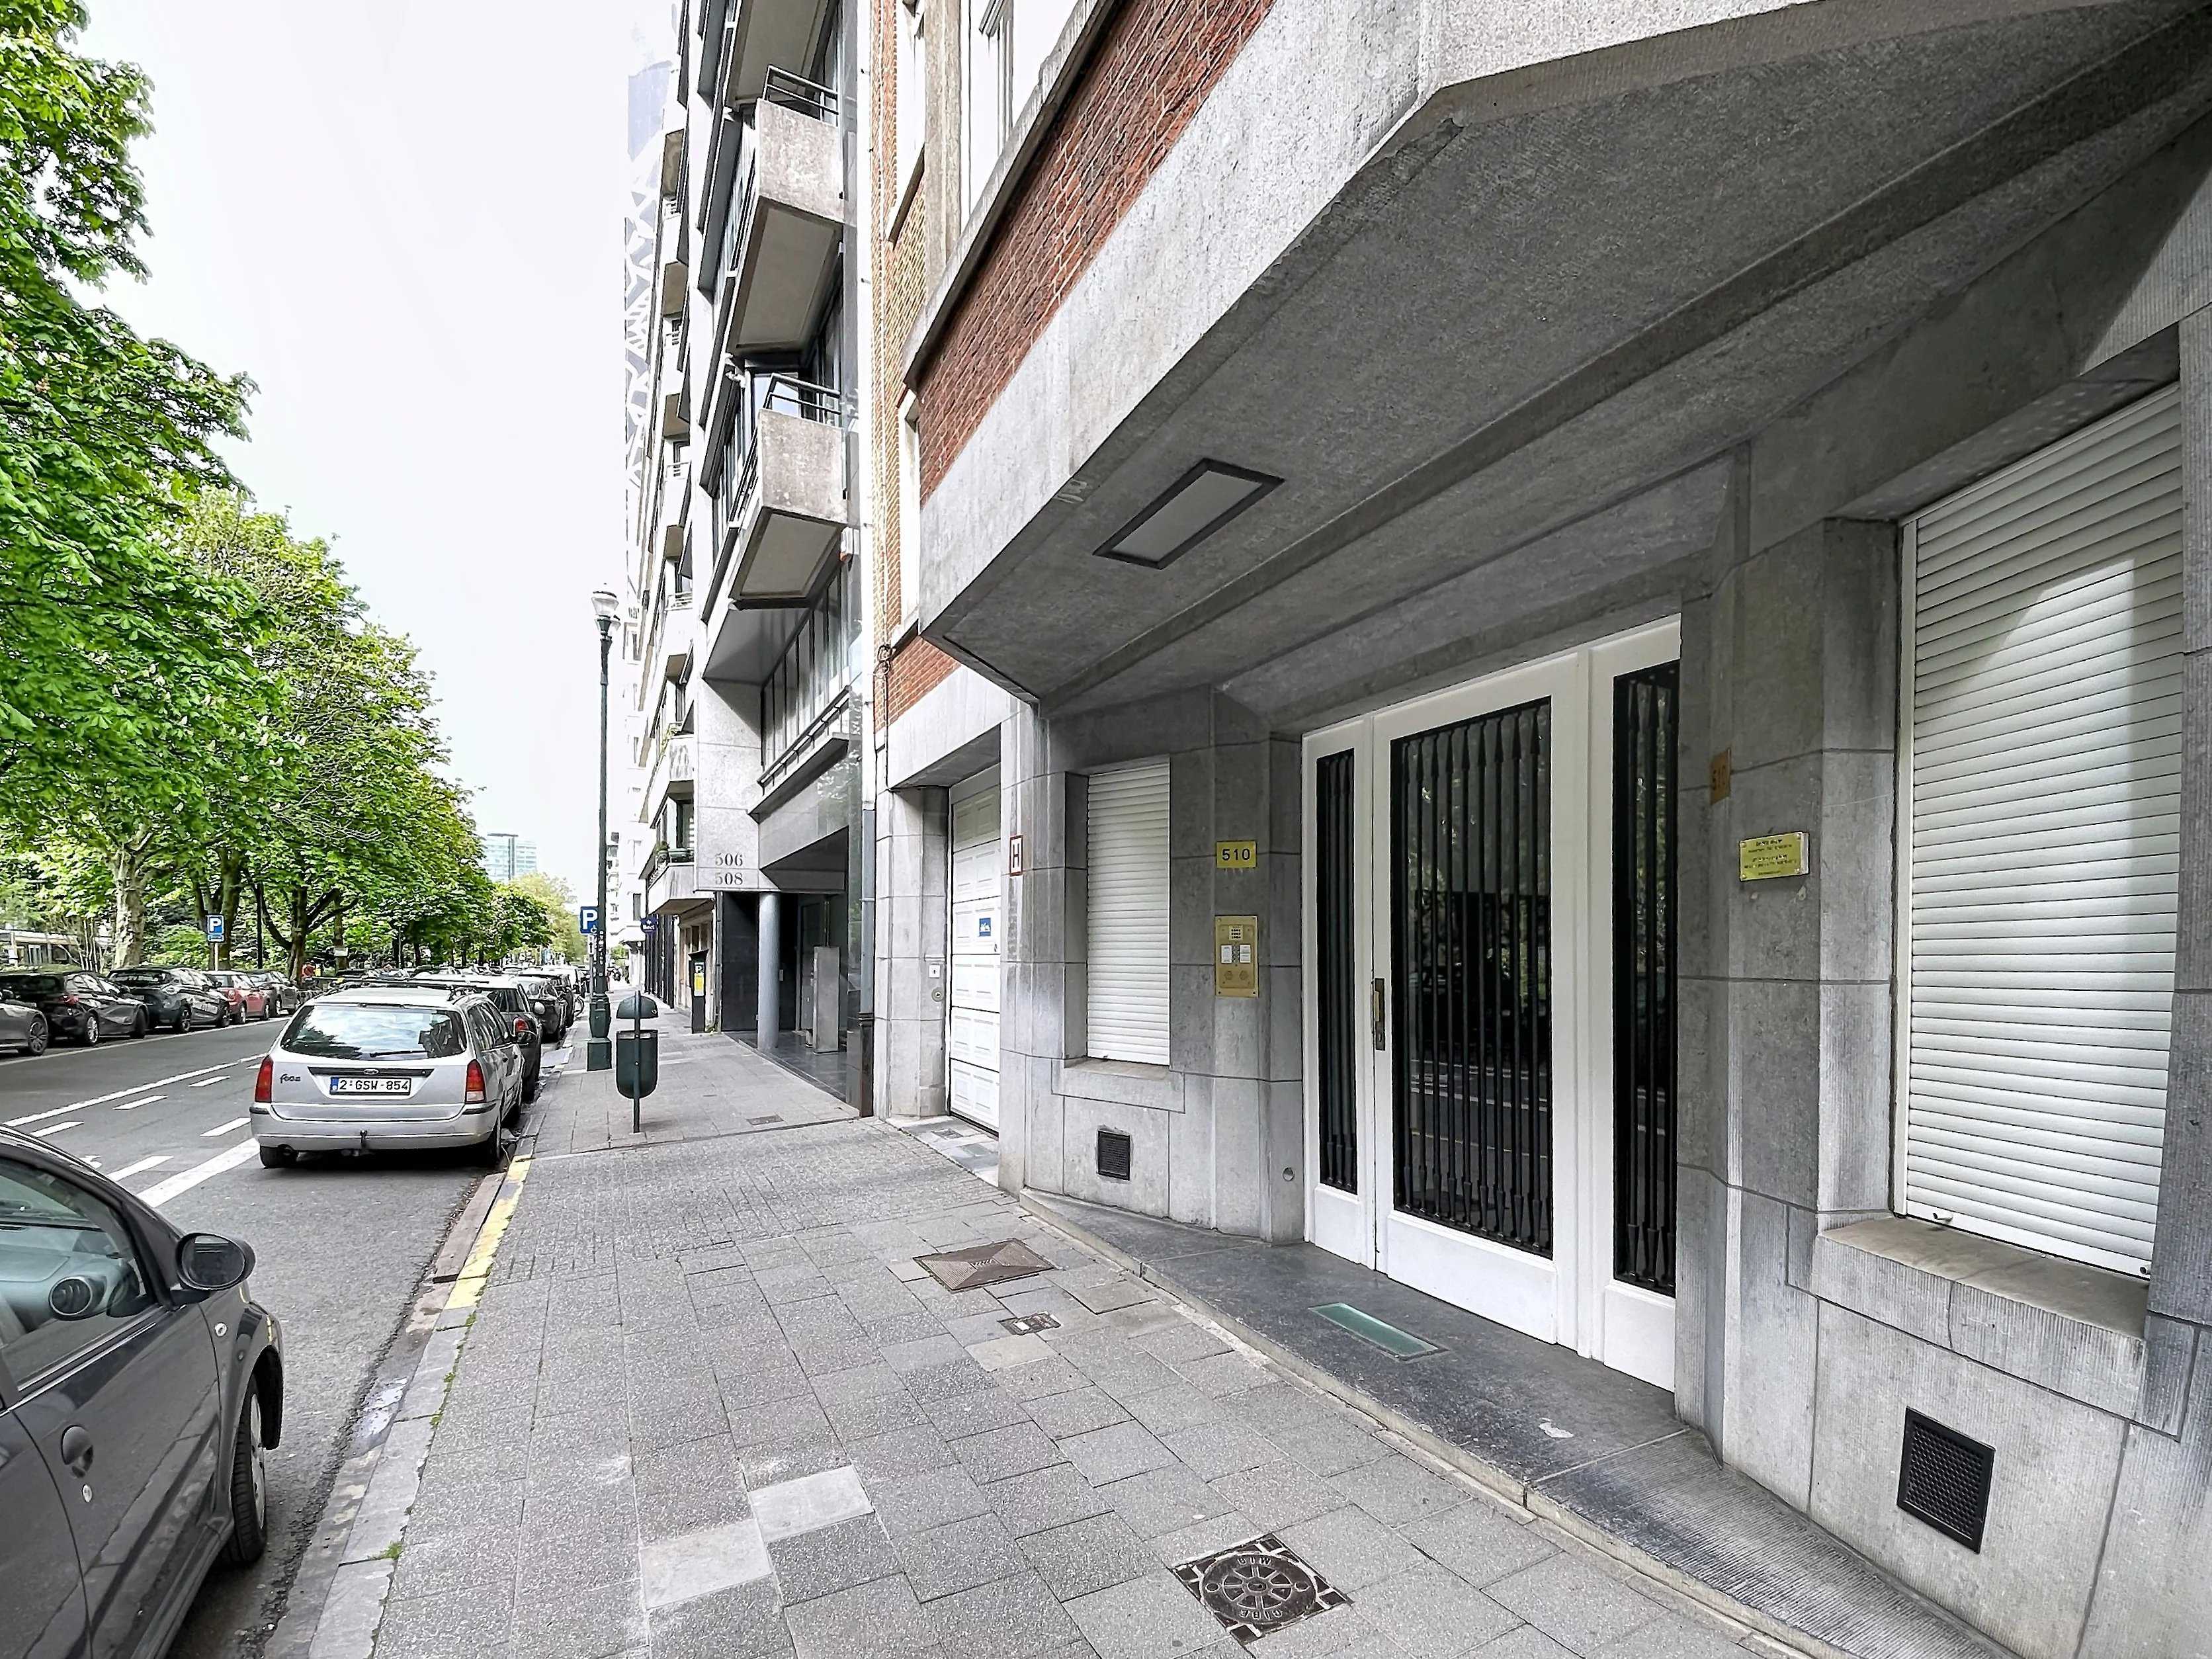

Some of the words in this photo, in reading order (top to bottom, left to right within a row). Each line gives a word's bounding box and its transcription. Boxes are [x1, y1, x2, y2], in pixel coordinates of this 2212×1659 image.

[714, 852, 743, 867] 506
[1013, 843, 1019, 868] H
[1222, 848, 1250, 861] 510
[714, 872, 743, 885] 508
[209, 917, 222, 932] P
[582, 909, 597, 929] P
[695, 965, 702, 974] P
